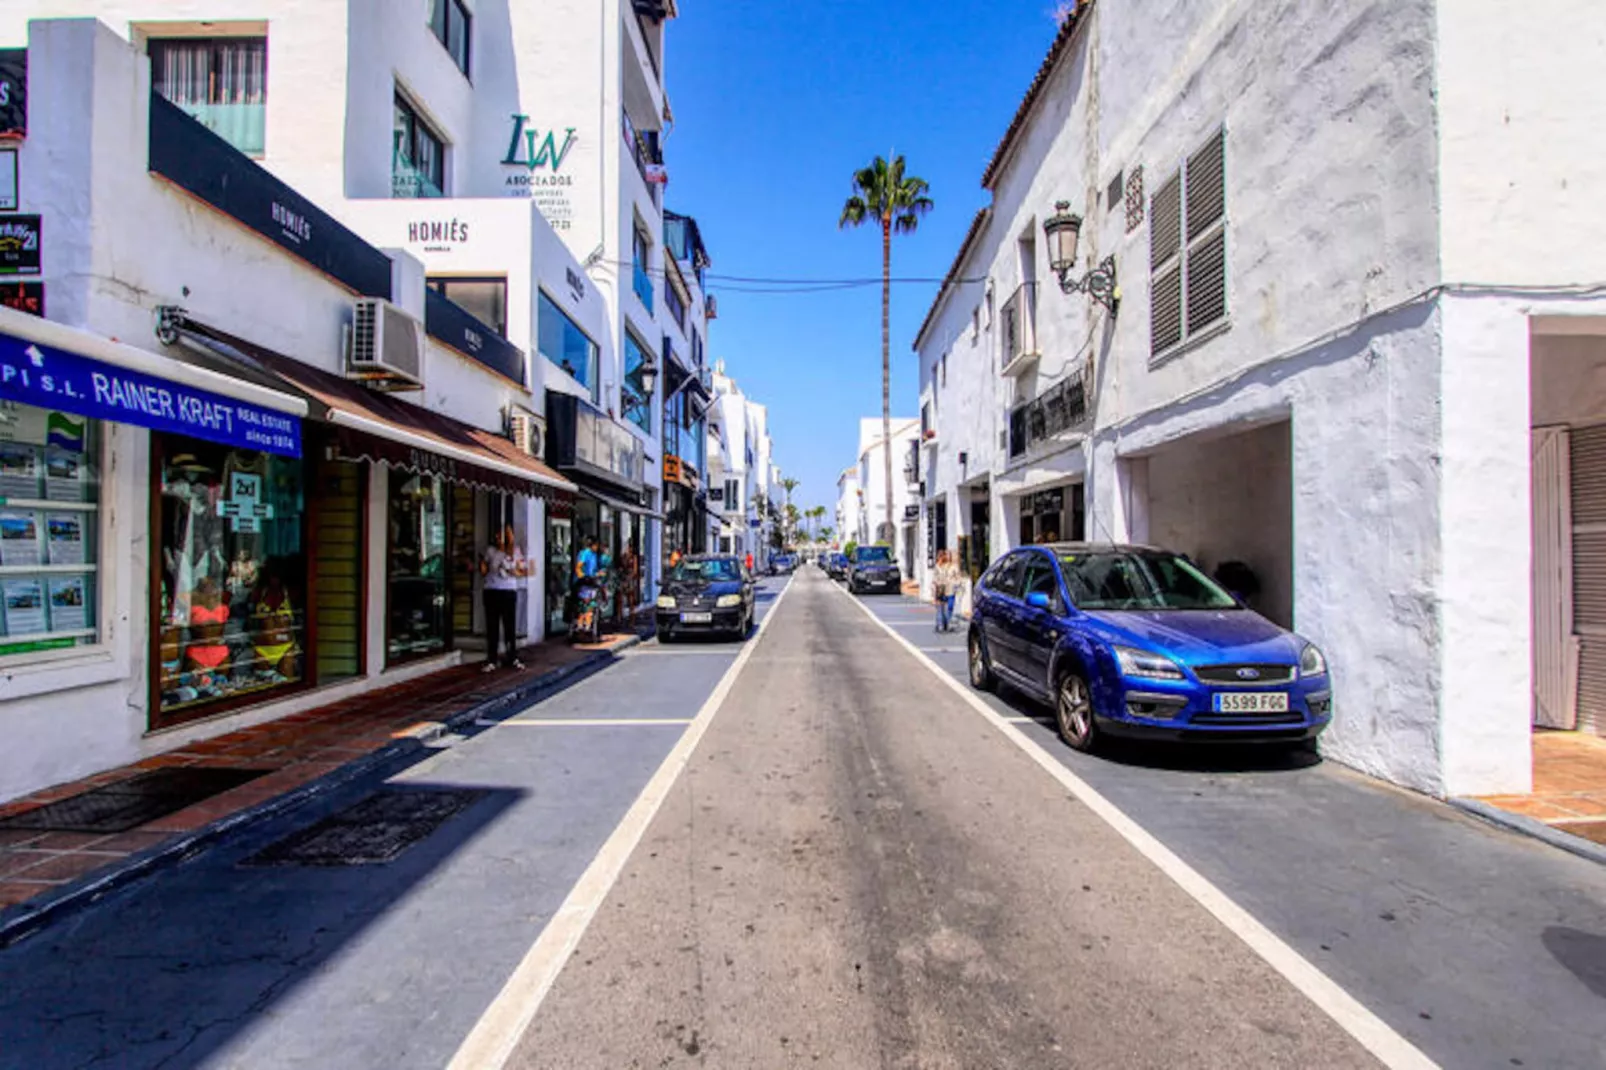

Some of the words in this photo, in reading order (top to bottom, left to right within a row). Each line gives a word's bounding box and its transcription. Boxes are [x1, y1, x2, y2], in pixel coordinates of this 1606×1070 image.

[505, 175, 572, 186] ASOCIADOS
[408, 217, 469, 243] HOMIÉS
[91, 371, 176, 420] RAINER
[177, 393, 234, 434] KRAFT
[237, 406, 261, 425] REAL
[1223, 695, 1257, 710] 5599
